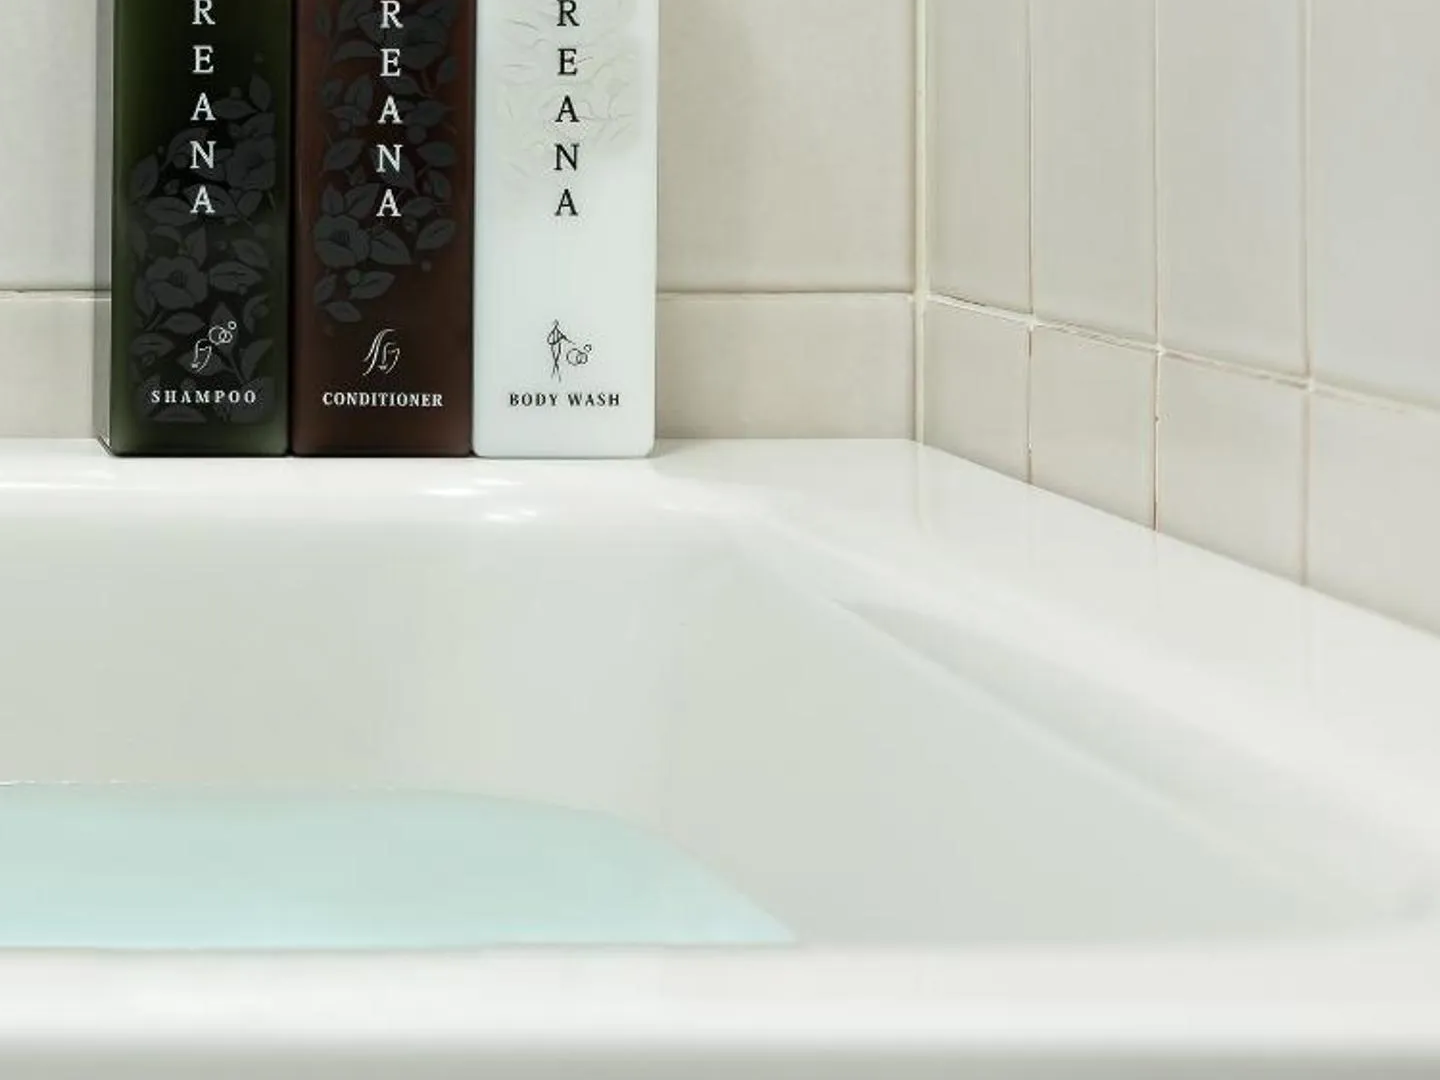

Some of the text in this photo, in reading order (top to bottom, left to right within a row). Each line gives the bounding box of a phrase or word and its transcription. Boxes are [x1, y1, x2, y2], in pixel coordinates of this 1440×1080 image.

[376, 0, 403, 217] REANA
[151, 390, 257, 404] SHAMPOO
[322, 392, 443, 407] CONDITIONER
[509, 392, 620, 407] BODY WASH
